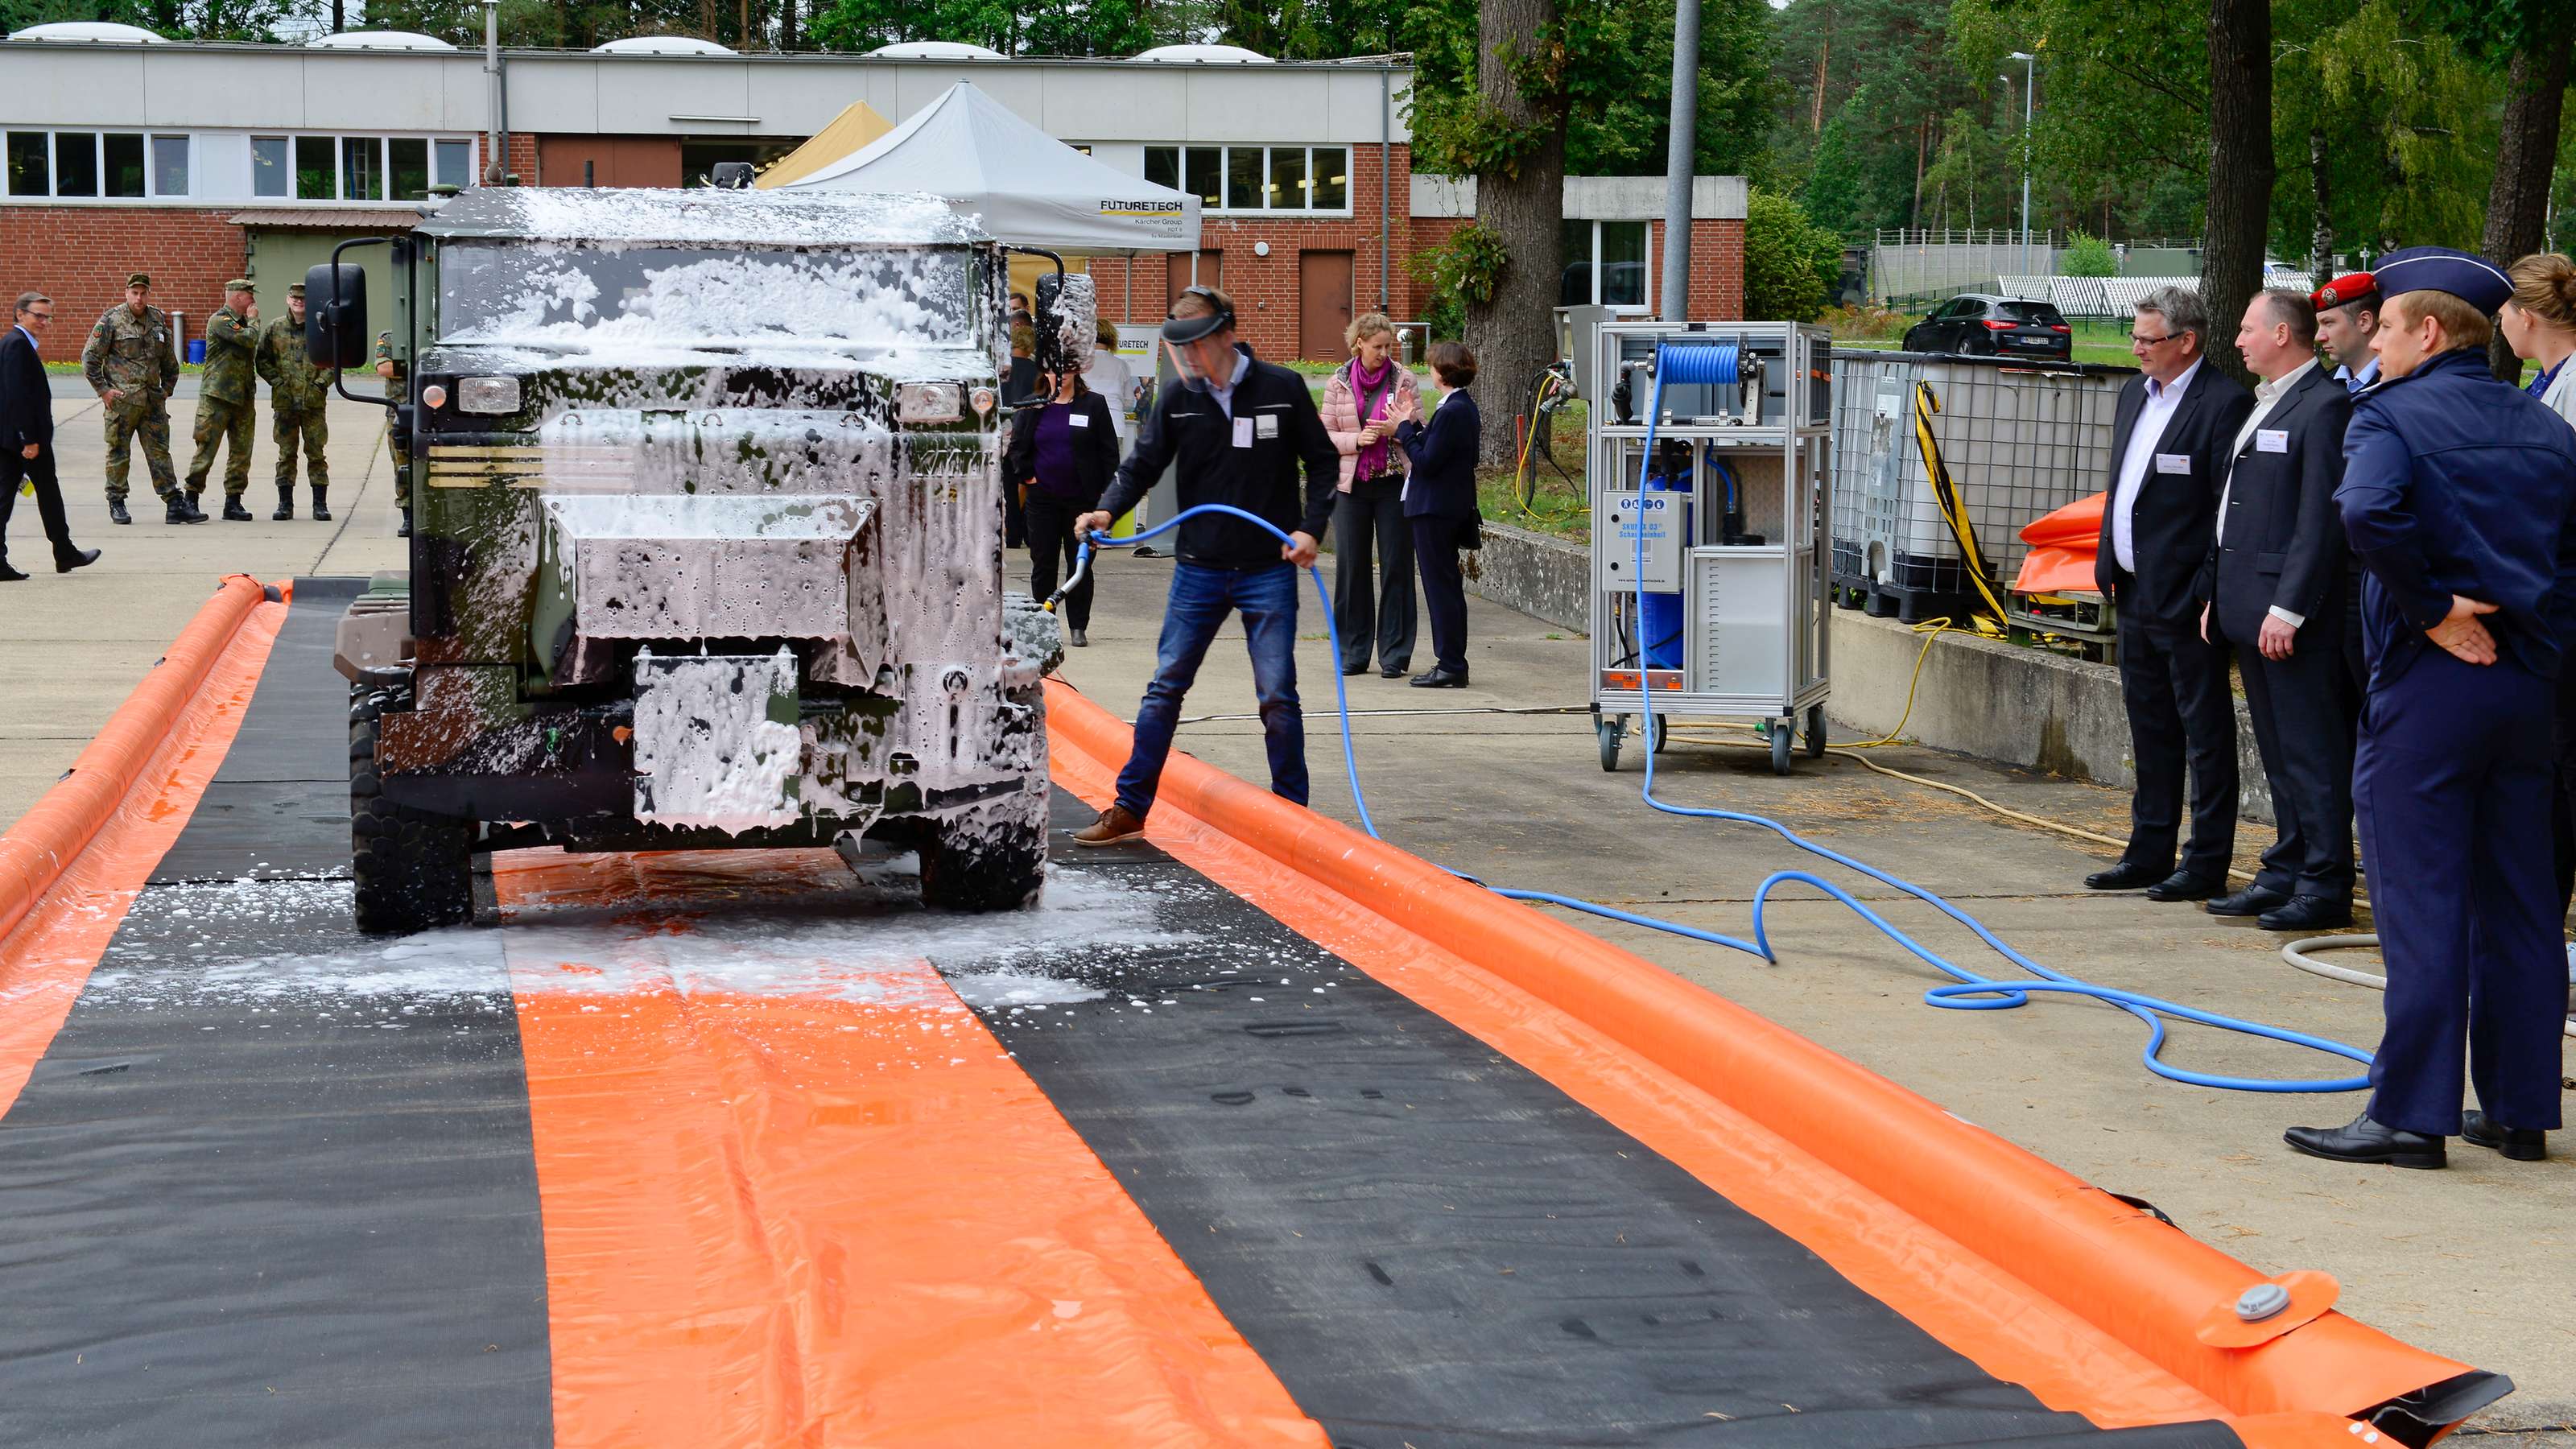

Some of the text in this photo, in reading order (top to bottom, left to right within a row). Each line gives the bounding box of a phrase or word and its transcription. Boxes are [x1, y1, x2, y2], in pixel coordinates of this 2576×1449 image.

[1100, 200, 1183, 211] FUTURETECH
[1162, 218, 1183, 226] Group
[1119, 340, 1149, 349] URETECH
